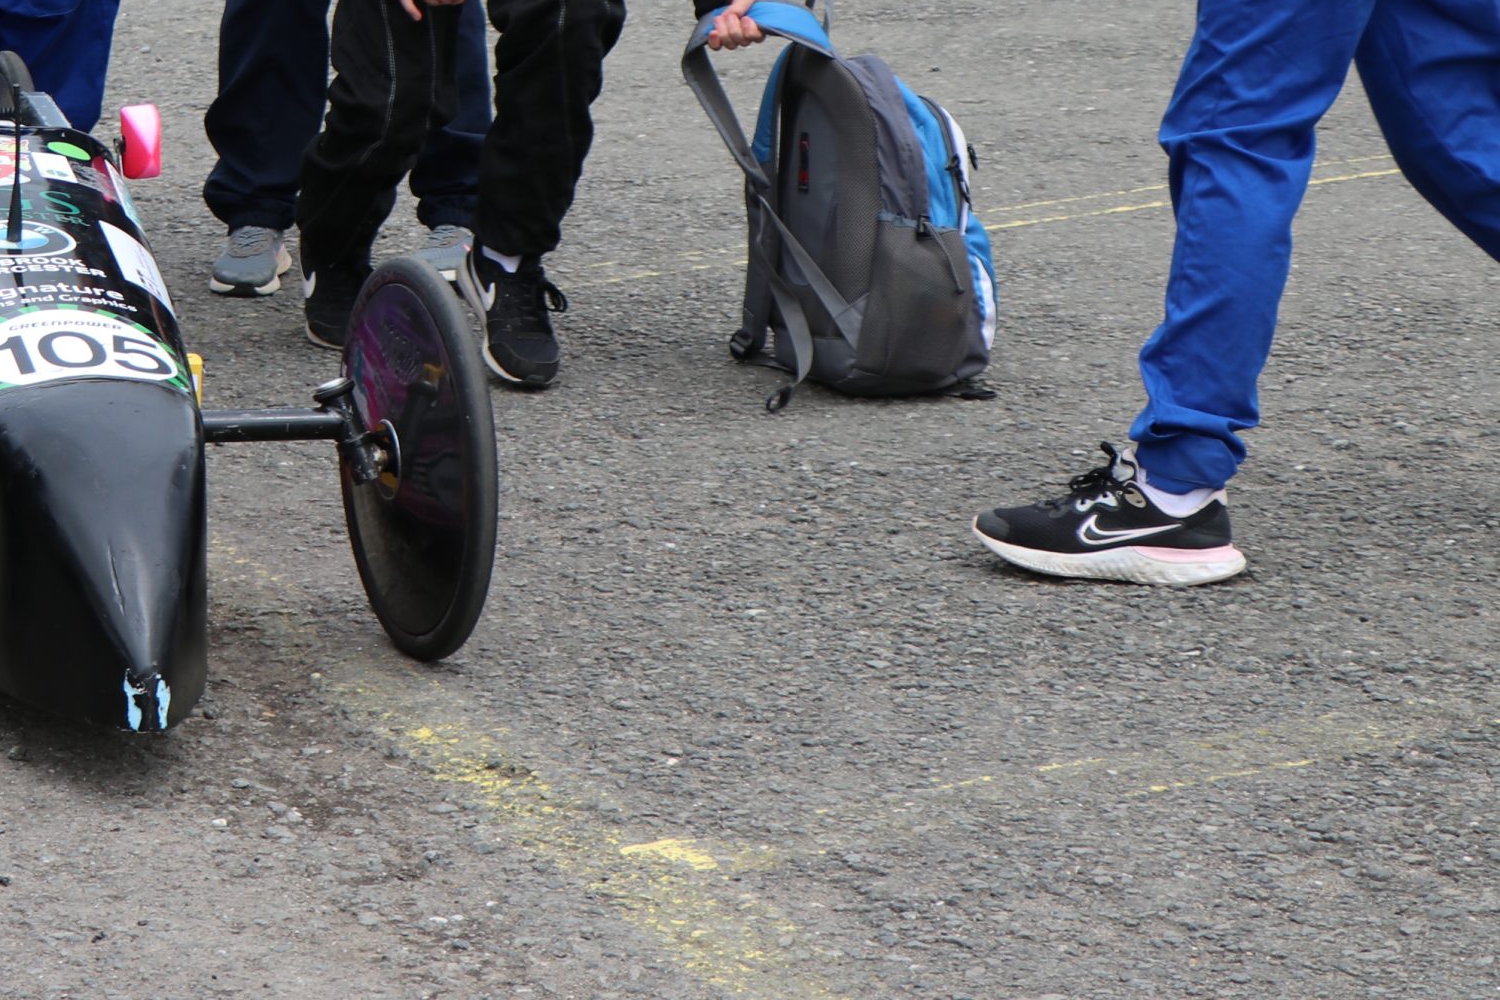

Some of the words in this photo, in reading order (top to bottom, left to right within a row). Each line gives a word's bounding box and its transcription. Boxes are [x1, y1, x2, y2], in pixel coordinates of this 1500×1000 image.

[20, 294, 55, 304] and
[58, 293, 138, 313] Graphics
[8, 320, 123, 333] GREENPOWER
